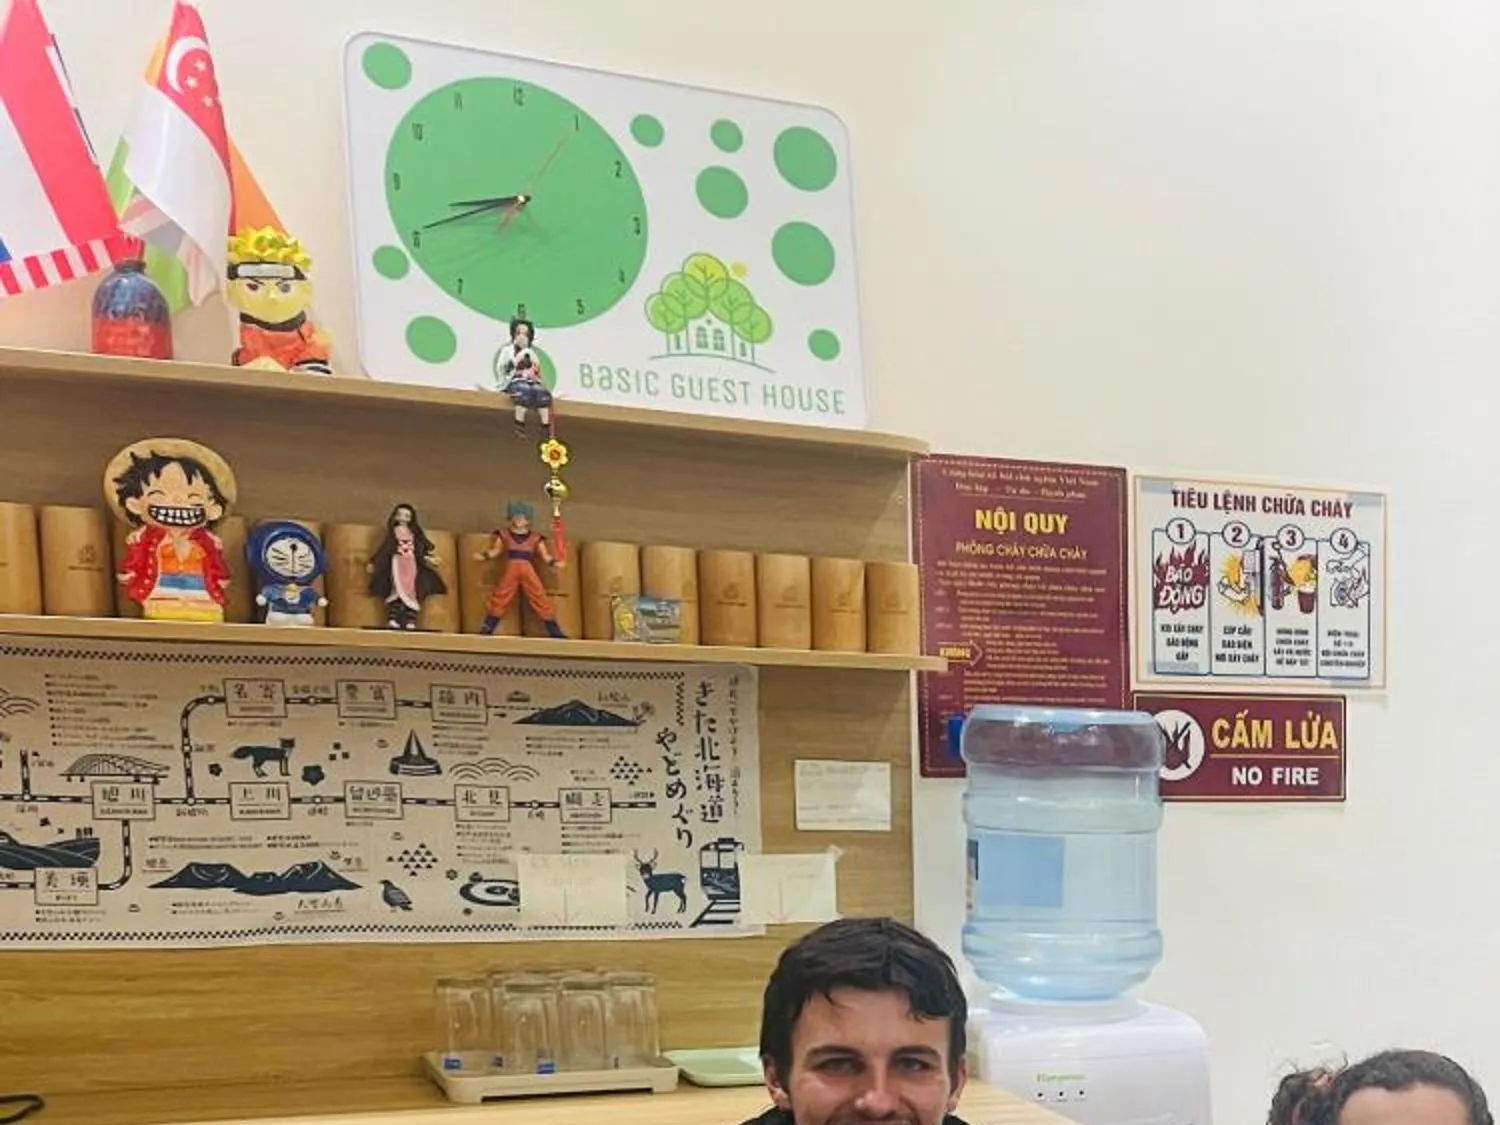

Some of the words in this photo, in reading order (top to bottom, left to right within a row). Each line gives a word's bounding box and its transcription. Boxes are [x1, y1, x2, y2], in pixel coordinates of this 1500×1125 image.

[671, 372, 752, 406] GUEST
[762, 383, 846, 415] HOUSE
[1172, 487, 1208, 509] TIÊU
[1213, 489, 1257, 515] LỆNH
[1261, 493, 1305, 516] CHỮA
[975, 505, 1017, 535] NỘI
[1023, 511, 1069, 535] QUY
[1176, 523, 1185, 539] 1
[1231, 526, 1243, 542] 2
[1285, 529, 1297, 546] 3
[1338, 533, 1349, 549] 4
[1211, 709, 1273, 749] CẤM
[1285, 710, 1338, 749] LỬA
[1231, 765, 1263, 785] NO
[1271, 766, 1320, 785] FIRE
[656, 727, 694, 848] やどめぐり
